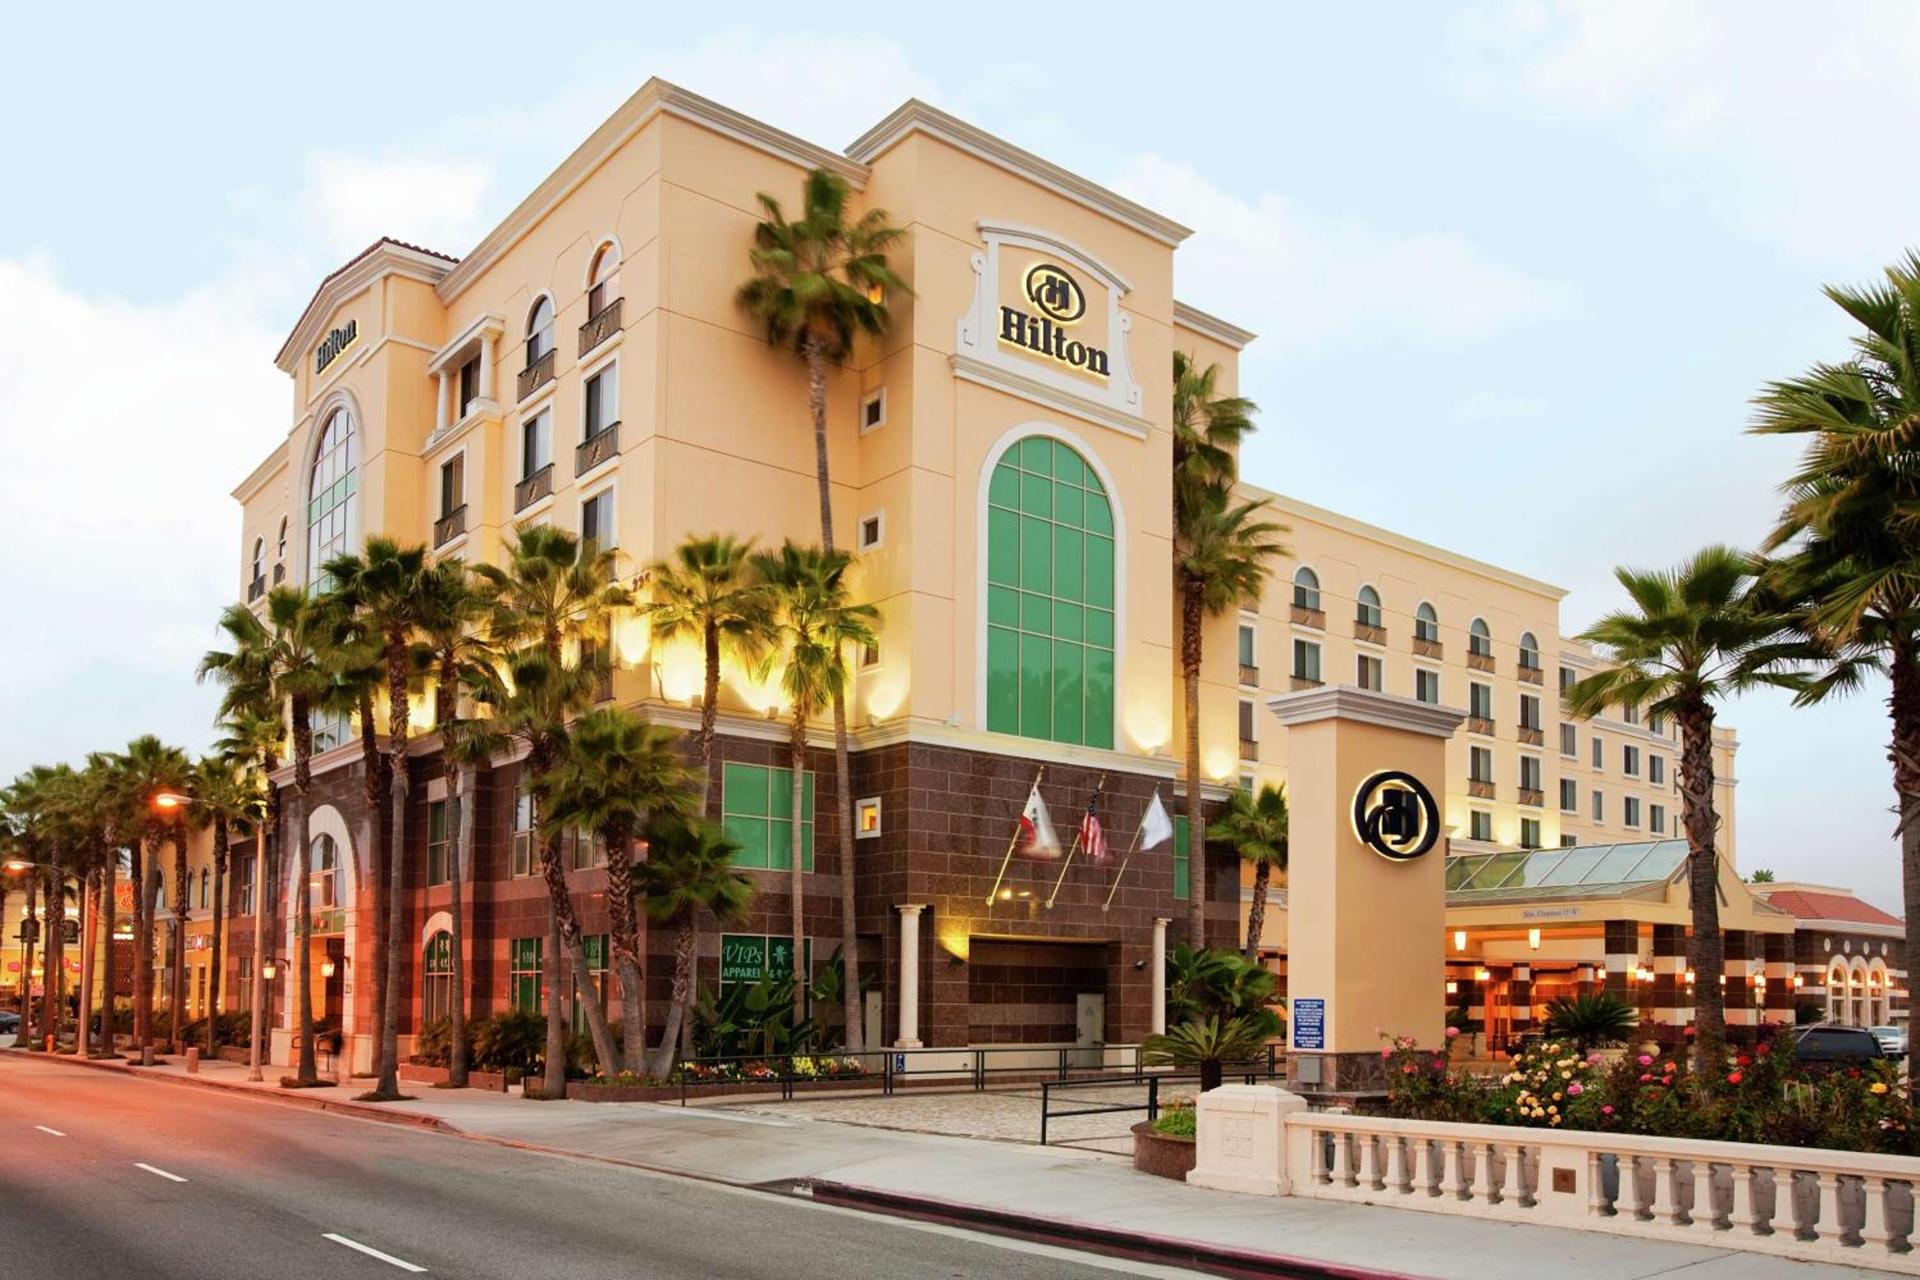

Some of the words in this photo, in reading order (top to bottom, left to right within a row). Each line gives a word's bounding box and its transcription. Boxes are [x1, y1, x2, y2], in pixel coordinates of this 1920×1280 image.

[316, 320, 357, 374] Hilton
[1000, 306, 1110, 376] Hilton
[723, 943, 762, 963] VIPs
